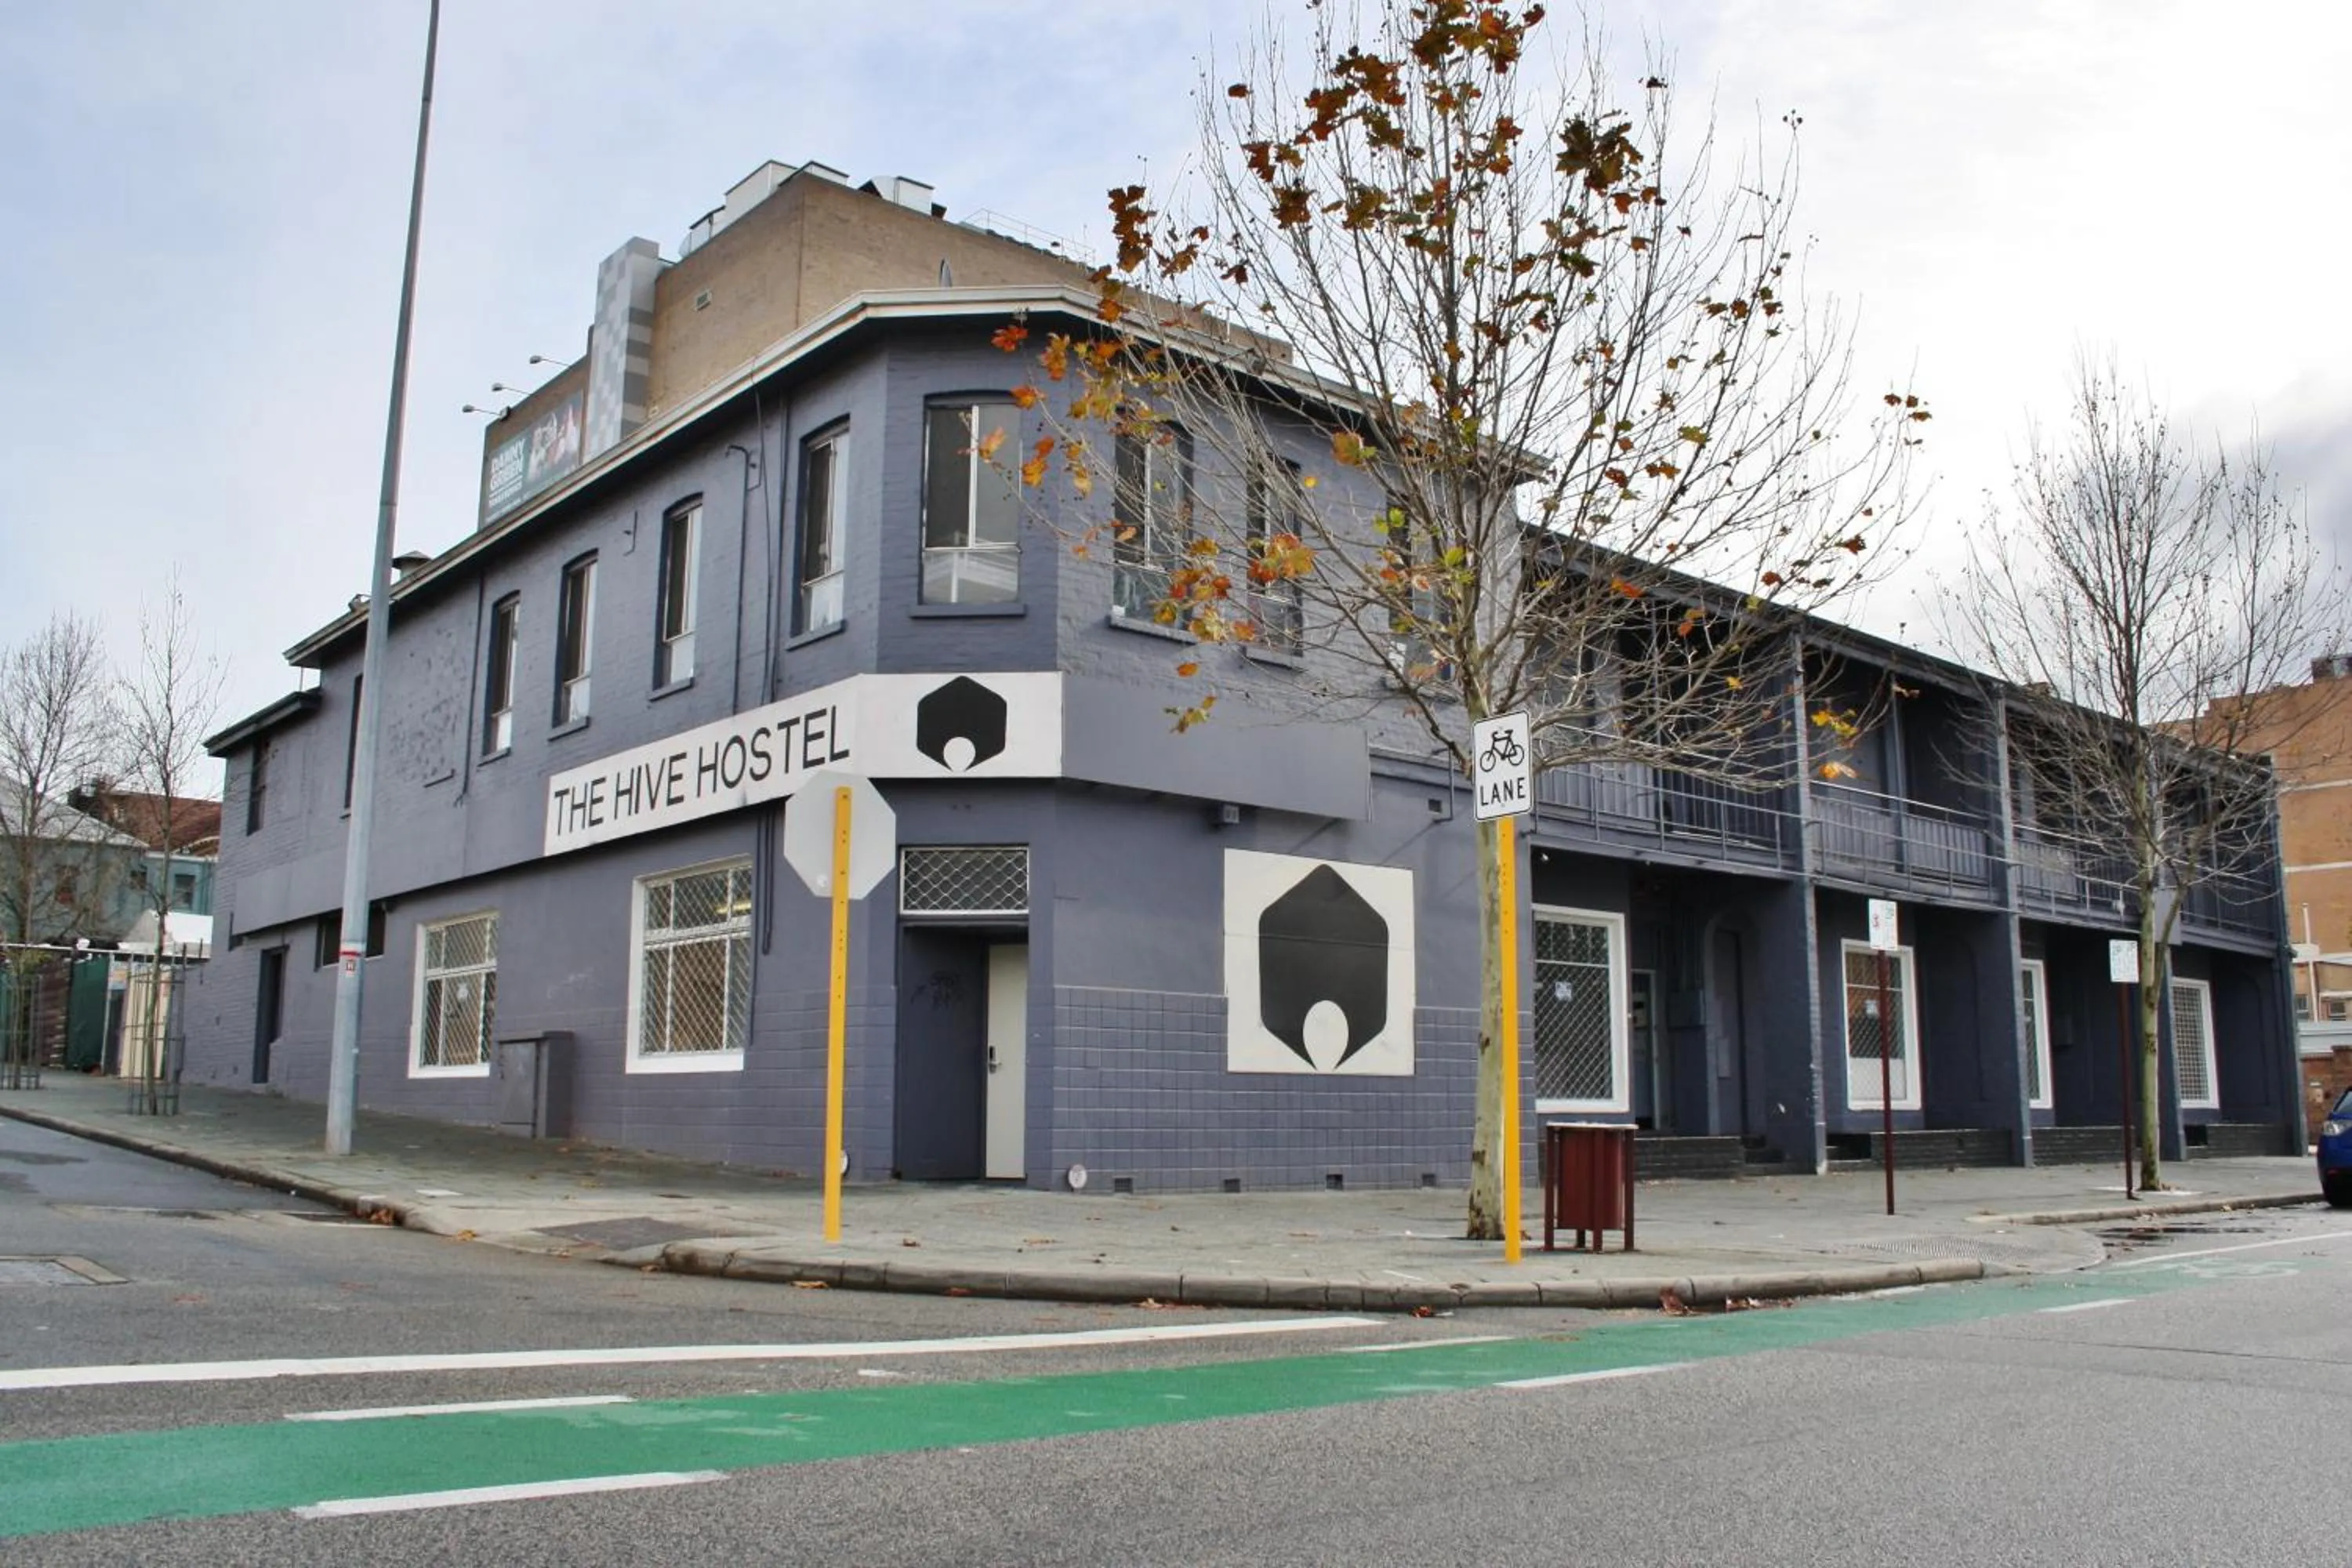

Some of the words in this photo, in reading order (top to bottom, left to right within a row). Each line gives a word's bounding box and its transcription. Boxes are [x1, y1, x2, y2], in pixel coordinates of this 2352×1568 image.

[554, 776, 608, 837] THE
[612, 752, 688, 821] HIVE
[697, 704, 850, 798] HOSTEL
[1479, 777, 1526, 807] LANE
